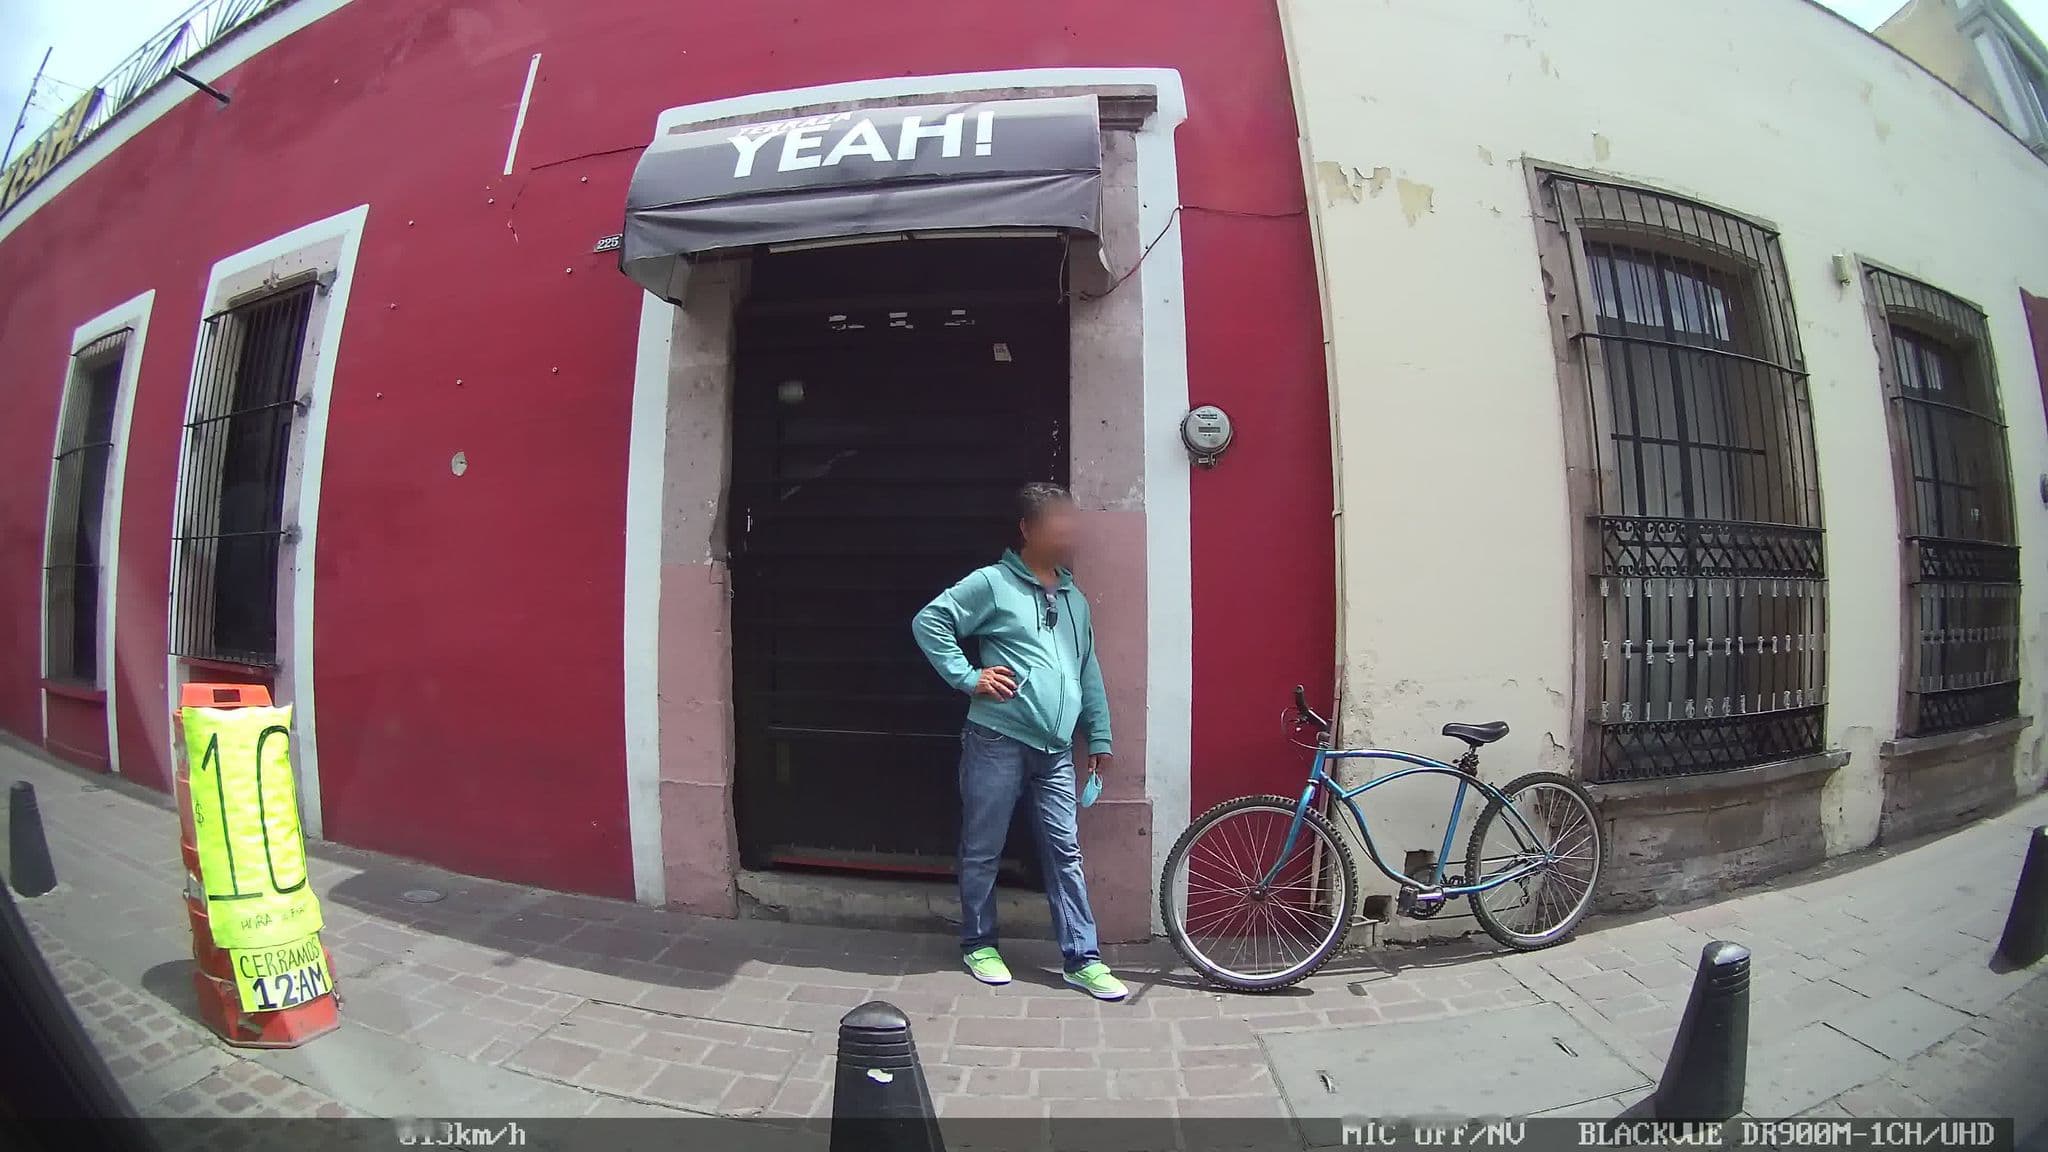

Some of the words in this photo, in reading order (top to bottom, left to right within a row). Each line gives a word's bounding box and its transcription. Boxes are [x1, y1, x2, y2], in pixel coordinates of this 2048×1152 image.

[728, 111, 994, 178] YEAH!
[596, 236, 621, 250] 225
[201, 725, 307, 900] 10
[240, 937, 320, 979] CERRAMOS
